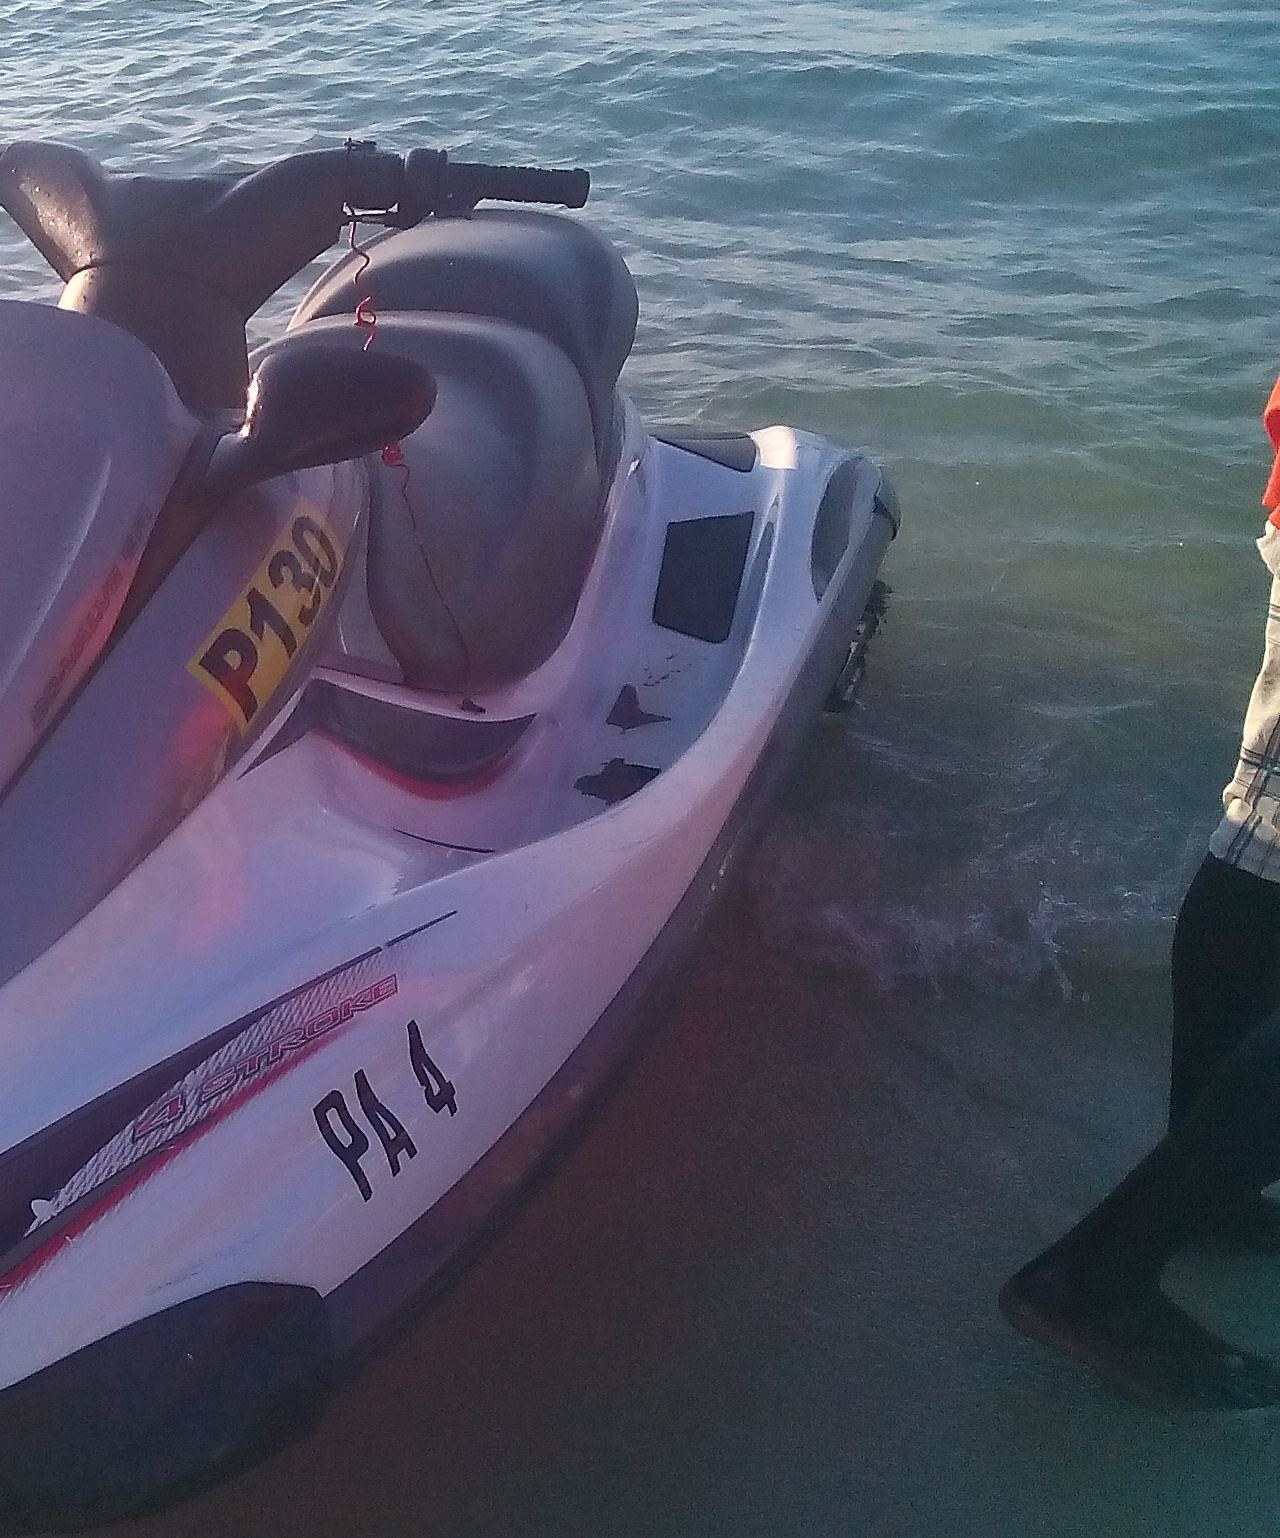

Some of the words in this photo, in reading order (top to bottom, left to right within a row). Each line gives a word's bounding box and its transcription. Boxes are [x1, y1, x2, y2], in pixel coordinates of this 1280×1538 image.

[199, 515, 339, 723] P130
[131, 1094, 186, 1143] 4
[200, 973, 399, 1103] STROKE
[312, 1068, 418, 1203] PA
[406, 1019, 459, 1117] 4
